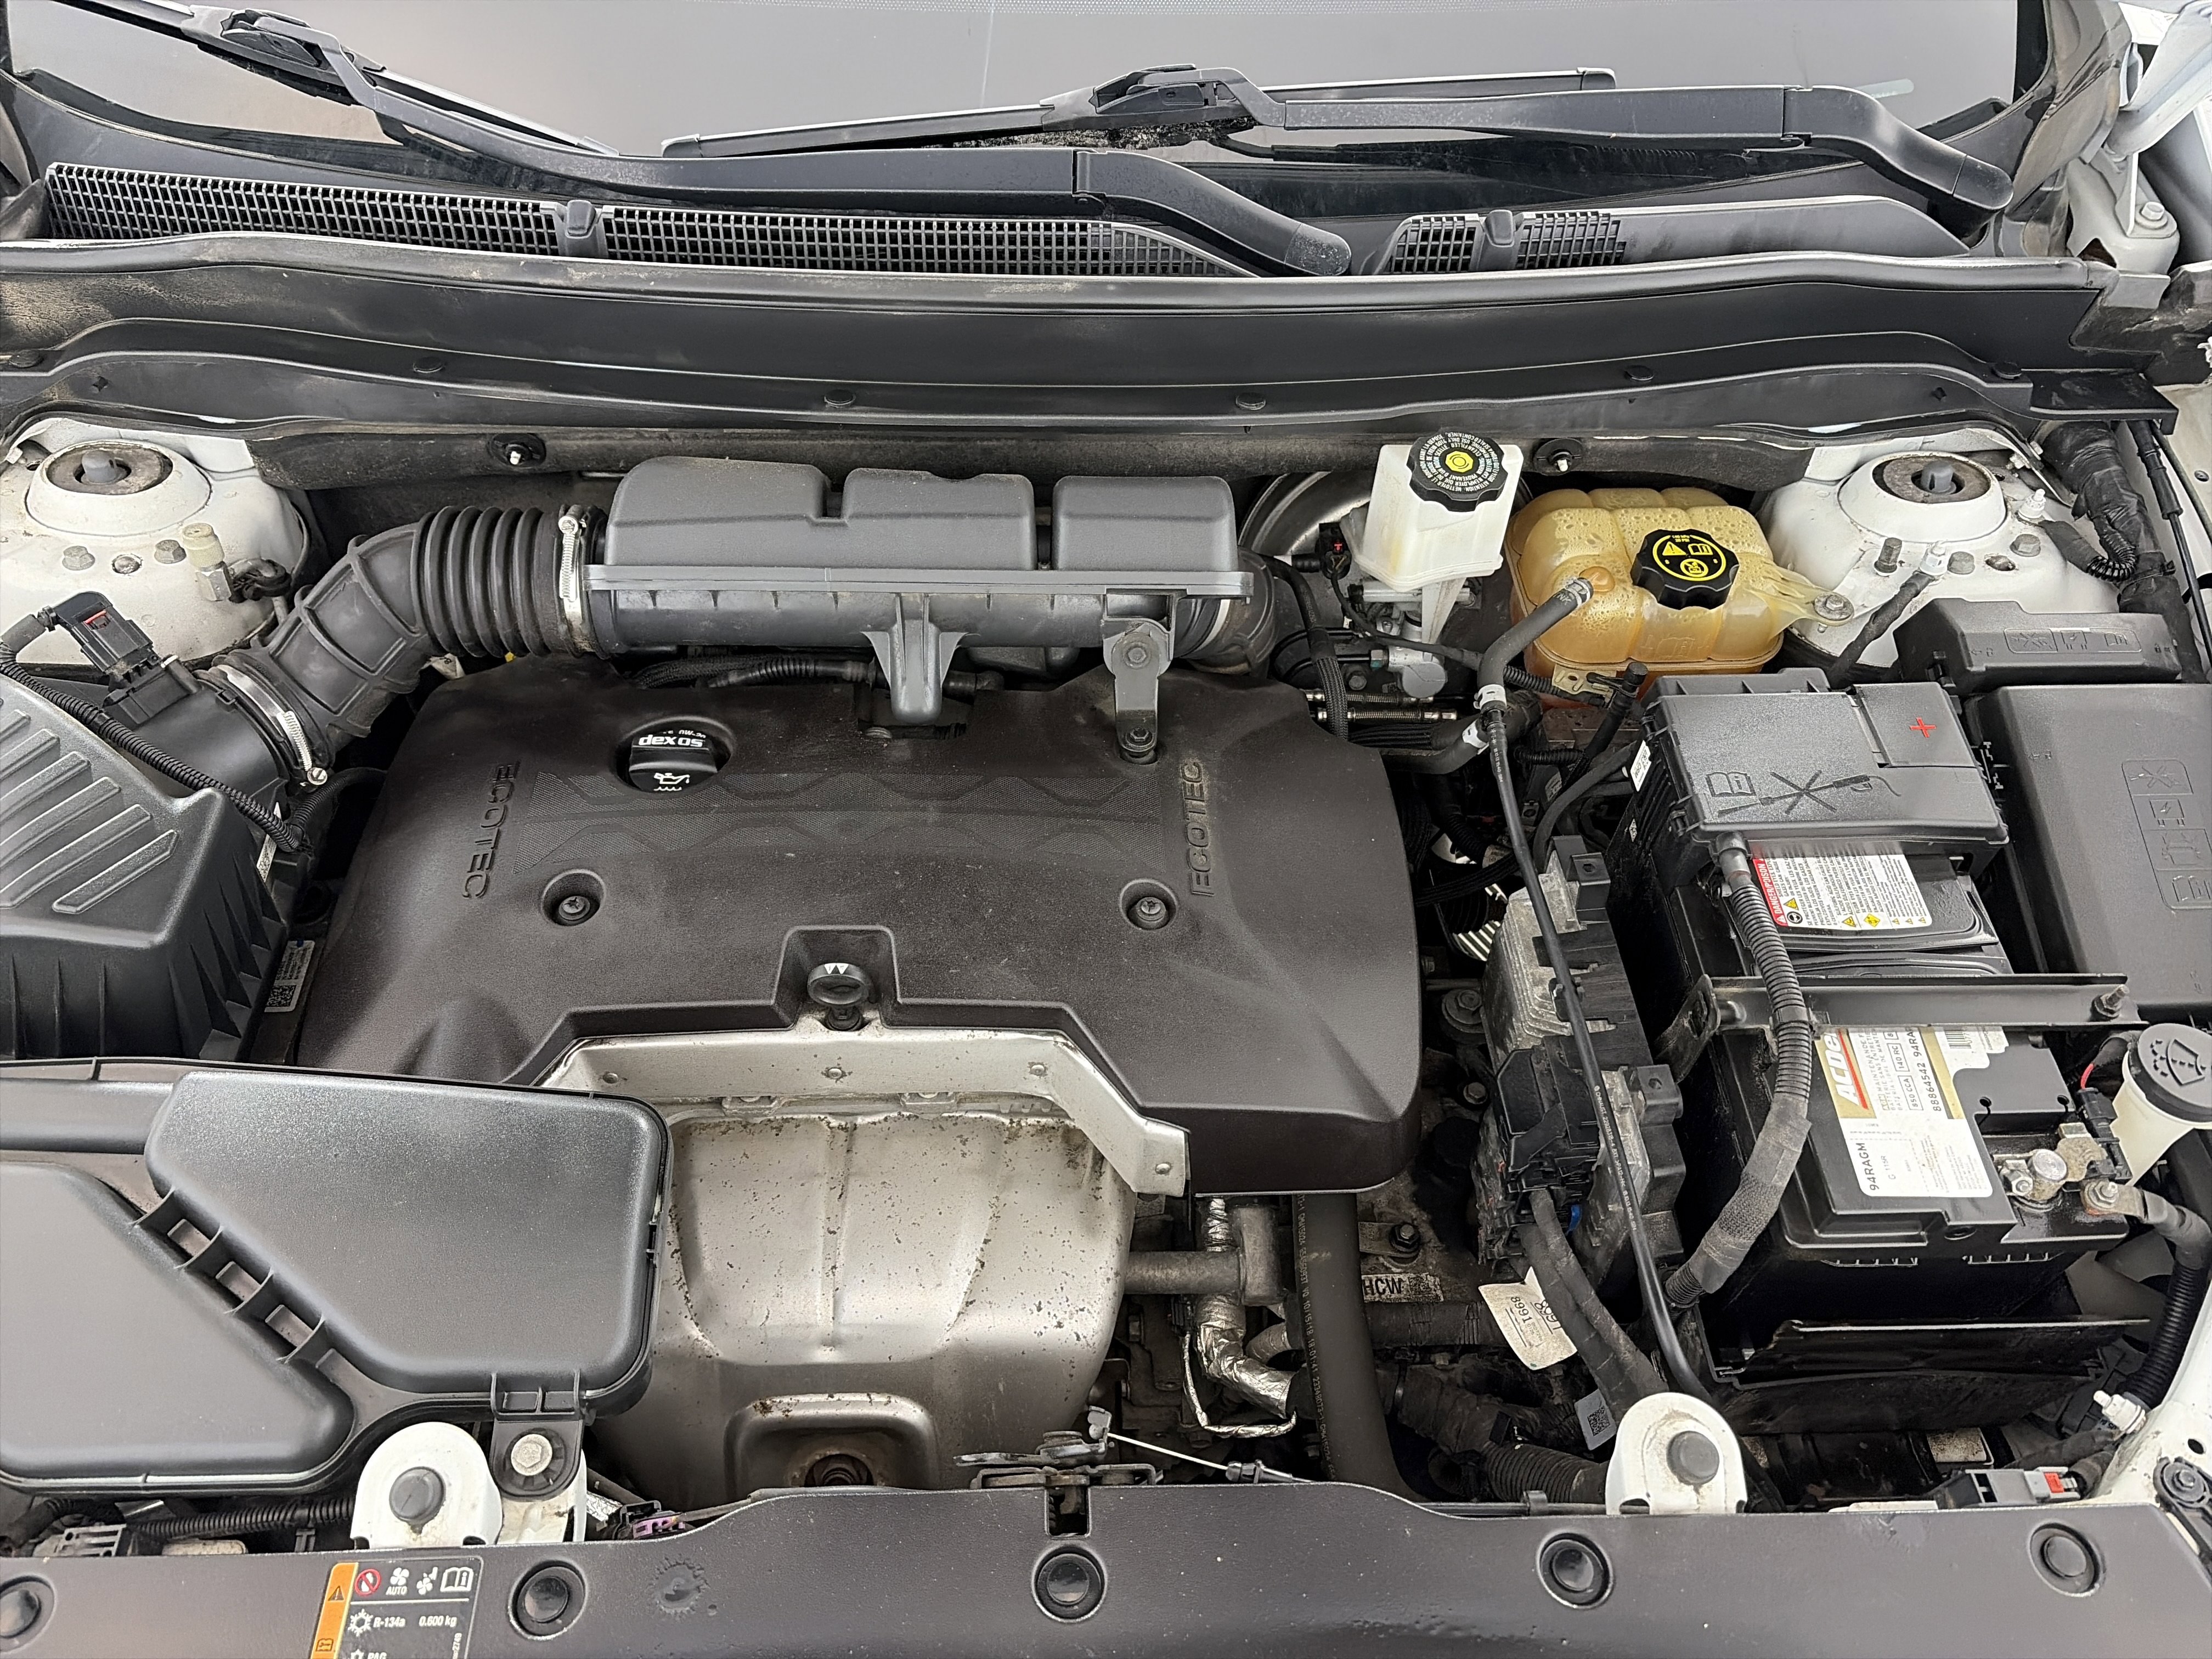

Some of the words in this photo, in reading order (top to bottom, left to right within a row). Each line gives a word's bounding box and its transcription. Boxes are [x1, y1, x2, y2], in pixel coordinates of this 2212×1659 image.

[1474, 437, 1491, 449] SEALED
[1435, 481, 1461, 491] NETTOYER
[1448, 472, 1478, 482] PROVENANT
[639, 735, 703, 747] dexos
[462, 763, 519, 901] ECOTEC
[1188, 759, 1217, 898] ECOTEC
[1798, 864, 1807, 876] GASES
[1757, 864, 1782, 914] DANGER/POISON
[1775, 883, 1783, 897] SHIELD
[1781, 883, 1789, 896] GASES
[1813, 885, 1821, 899] PUEDEN
[1818, 900, 1831, 926] EXPLOSIVOS
[1831, 896, 1841, 915] SULFURIC
[1809, 909, 1819, 926] PEUVENT
[1815, 908, 1825, 925] PROTEJA
[1892, 1046, 1900, 1054] RC
[1875, 1063, 1885, 1079] SANS
[1895, 1057, 1904, 1069] 140
[1903, 1078, 1912, 1092] CCA
[1917, 1063, 1941, 1111] 88864542
[1881, 1081, 1896, 1110] BATTERIE
[1909, 1094, 1918, 1107] 850
[1855, 1143, 1880, 1190] 94RAGM
[1881, 1156, 1890, 1170] 115R
[1362, 1278, 1403, 1295] HCW
[1303, 1300, 1314, 1335] 10/15/18
[1510, 1296, 1533, 1324] 8991
[1307, 1339, 1319, 1373] 18:01:41
[386, 1585, 407, 1595] AUTO
[373, 1617, 406, 1628] R-134a
[419, 1616, 443, 1627] 0.600
[444, 1615, 457, 1628] kg
